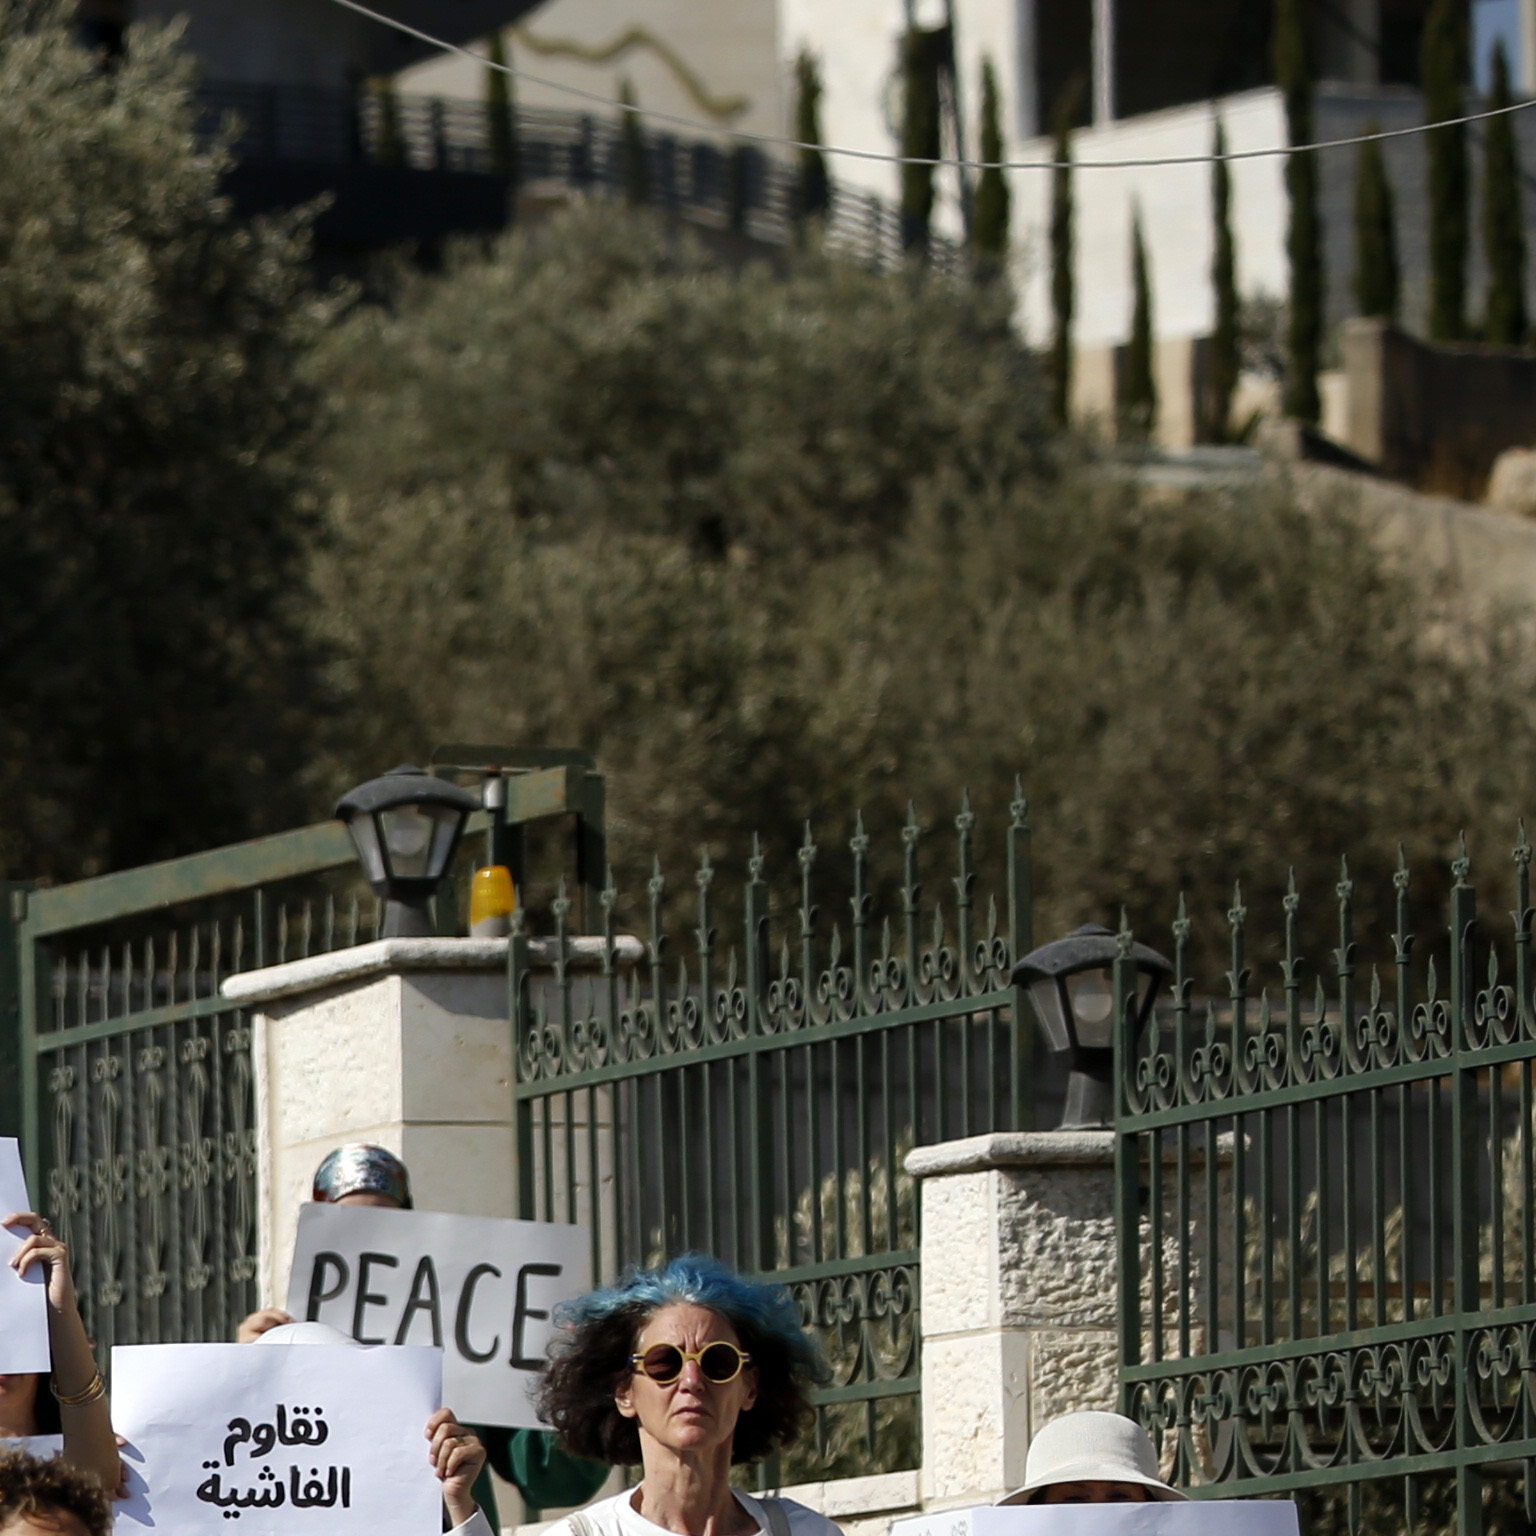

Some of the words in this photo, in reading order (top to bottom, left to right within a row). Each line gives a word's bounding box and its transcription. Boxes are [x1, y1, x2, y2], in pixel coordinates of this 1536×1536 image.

[306, 1250, 562, 1371] PEACE
[223, 1403, 329, 1466] نقاوم
[195, 1459, 352, 1520] الفاشية
